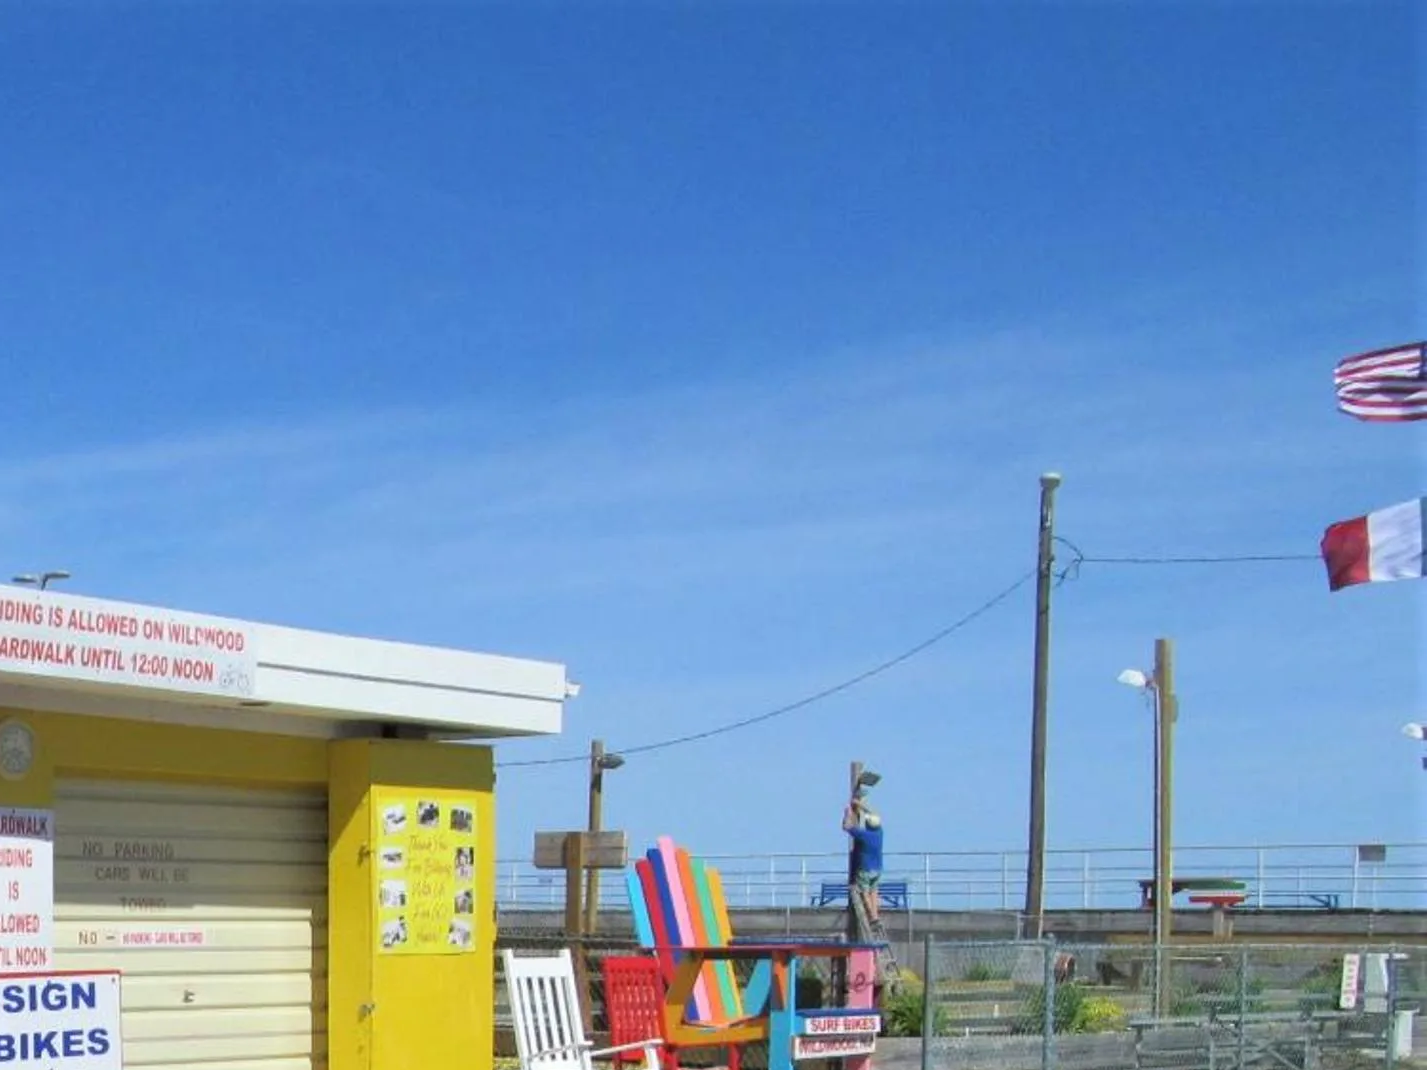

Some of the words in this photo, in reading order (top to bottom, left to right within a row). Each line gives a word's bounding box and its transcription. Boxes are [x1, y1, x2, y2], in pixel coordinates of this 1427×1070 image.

[48, 606, 63, 628] IS
[68, 608, 138, 638] ALLOWED
[143, 619, 163, 641] ON
[168, 622, 244, 652] WILDWOOD
[80, 647, 125, 672] UNTIL
[131, 654, 168, 677] 12:00
[172, 659, 214, 682] NOON
[82, 841, 103, 856] NO
[114, 841, 174, 860] PARKING
[8, 881, 19, 901] IS
[79, 930, 97, 944] NO
[16, 946, 47, 967] NOON
[2, 981, 96, 1013] SIGN
[811, 1018, 842, 1032] SURF
[843, 1017, 876, 1031] BIKES
